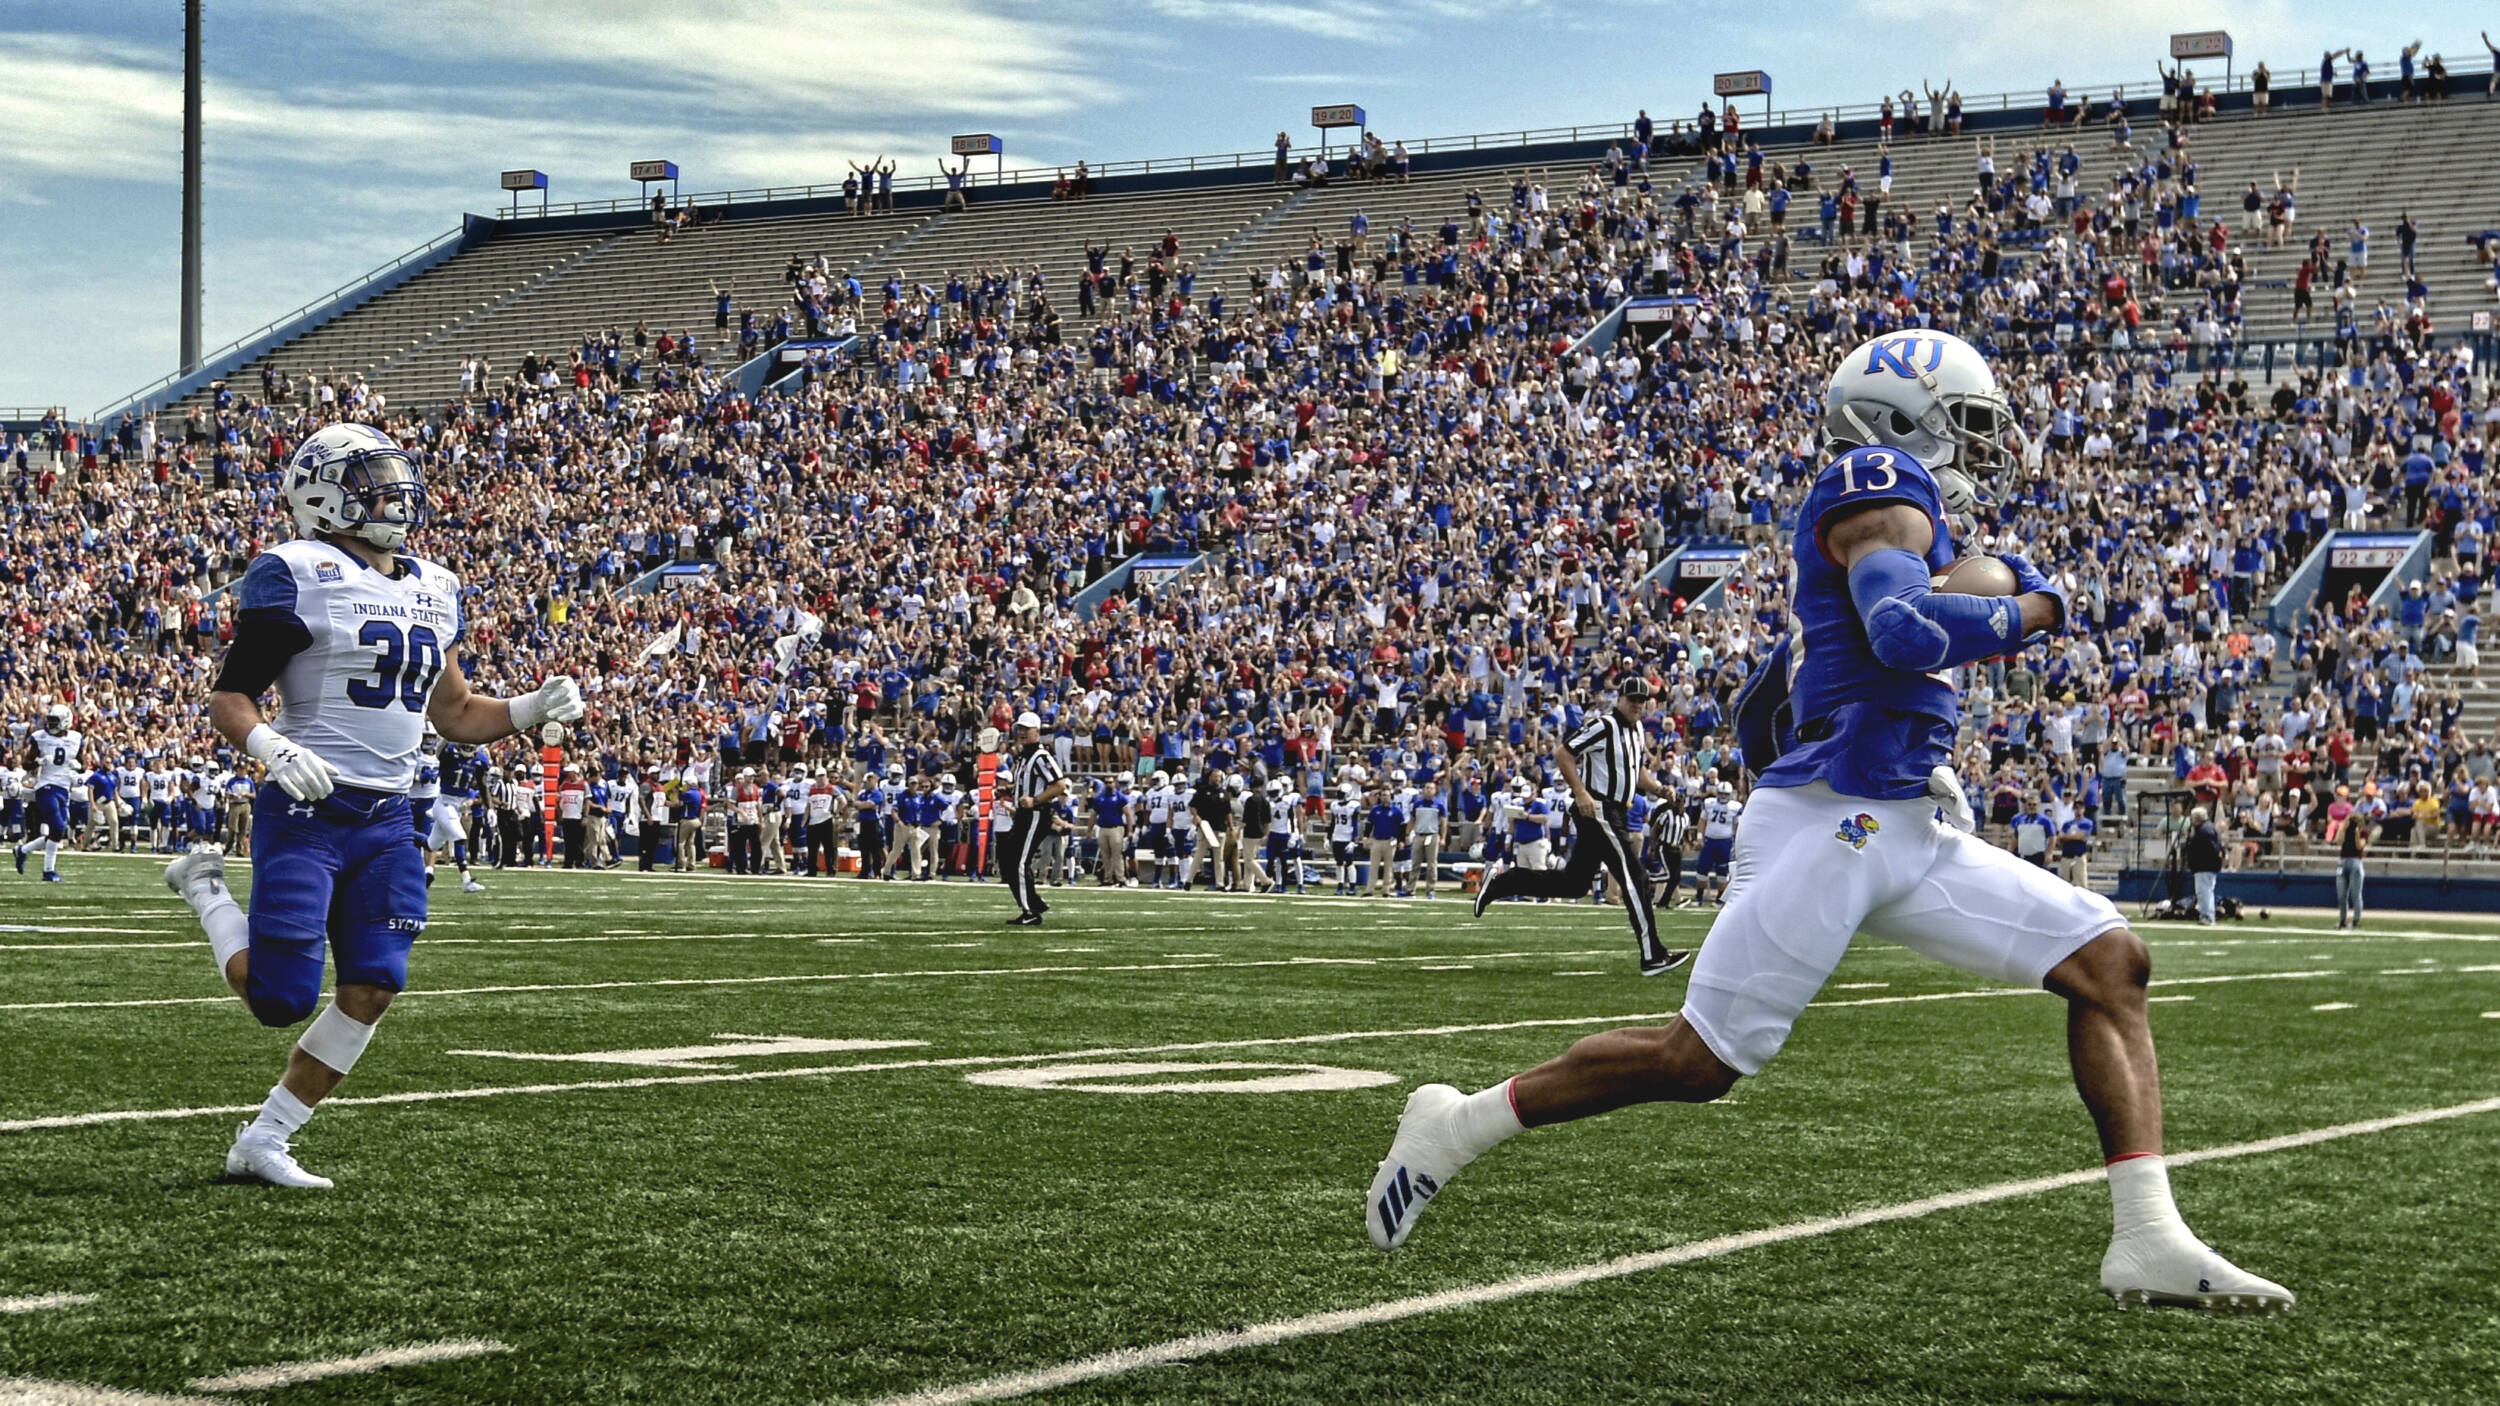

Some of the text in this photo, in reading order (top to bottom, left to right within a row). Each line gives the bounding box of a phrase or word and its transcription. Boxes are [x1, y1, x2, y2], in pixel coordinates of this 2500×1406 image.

[1717, 76, 1758, 89] 20 21
[1315, 109, 1352, 121] 19 20
[976, 138, 987, 149] 19
[633, 164, 663, 176] 17 18
[514, 175, 523, 184] 17
[1659, 308, 1671, 319] 21
[1864, 337, 1947, 379] KU
[1836, 453, 1898, 497] 13
[2340, 551, 2358, 565] 22
[1688, 563, 1702, 575] 21
[352, 603, 440, 624] INDIANA STATE
[346, 619, 441, 713] 30
[1711, 810, 1728, 823] 75
